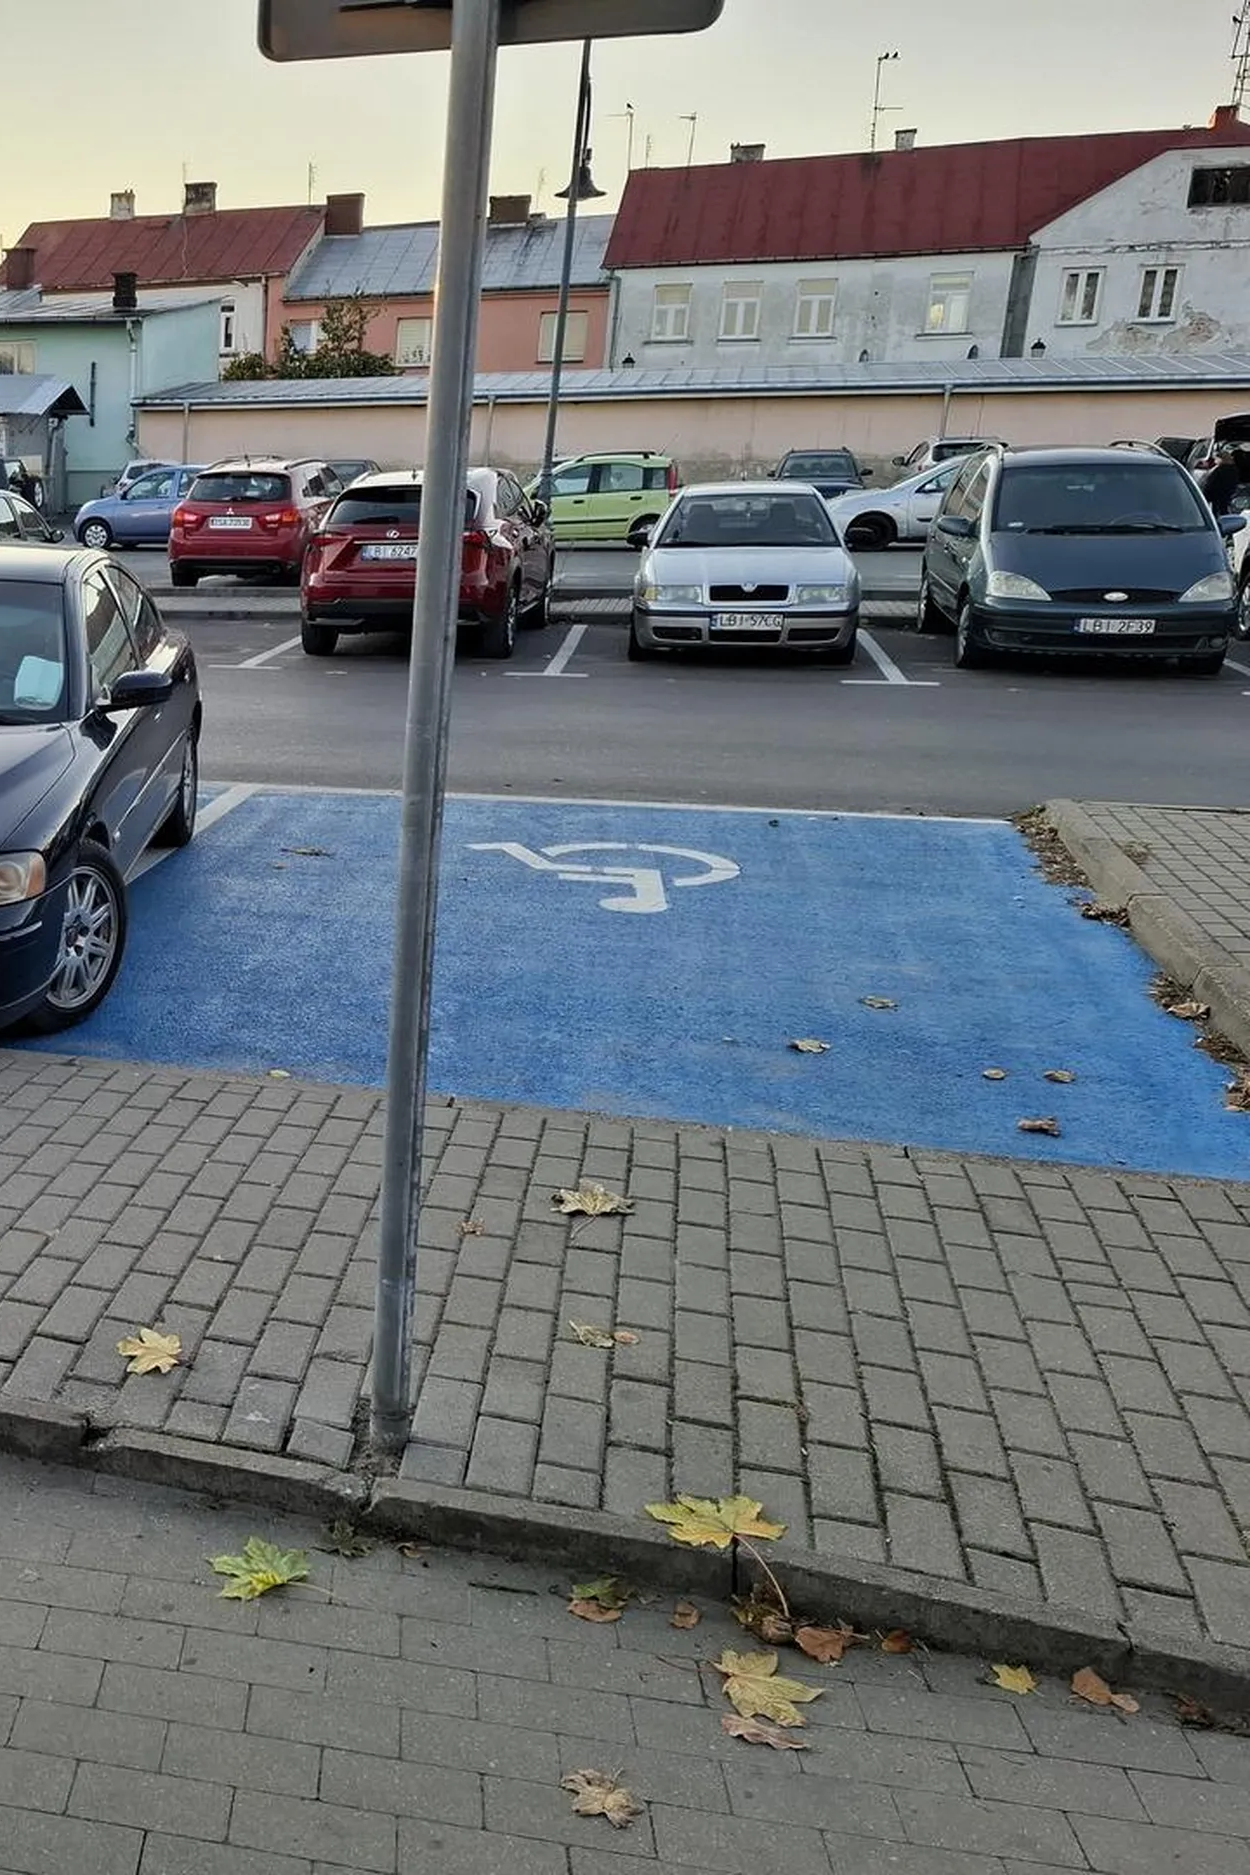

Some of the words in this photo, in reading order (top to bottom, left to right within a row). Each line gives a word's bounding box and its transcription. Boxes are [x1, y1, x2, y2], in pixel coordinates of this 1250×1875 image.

[391, 546, 417, 557] 6247
[720, 615, 744, 626] LBI
[1083, 620, 1110, 632] LBI
[1118, 621, 1152, 632] 2F39
